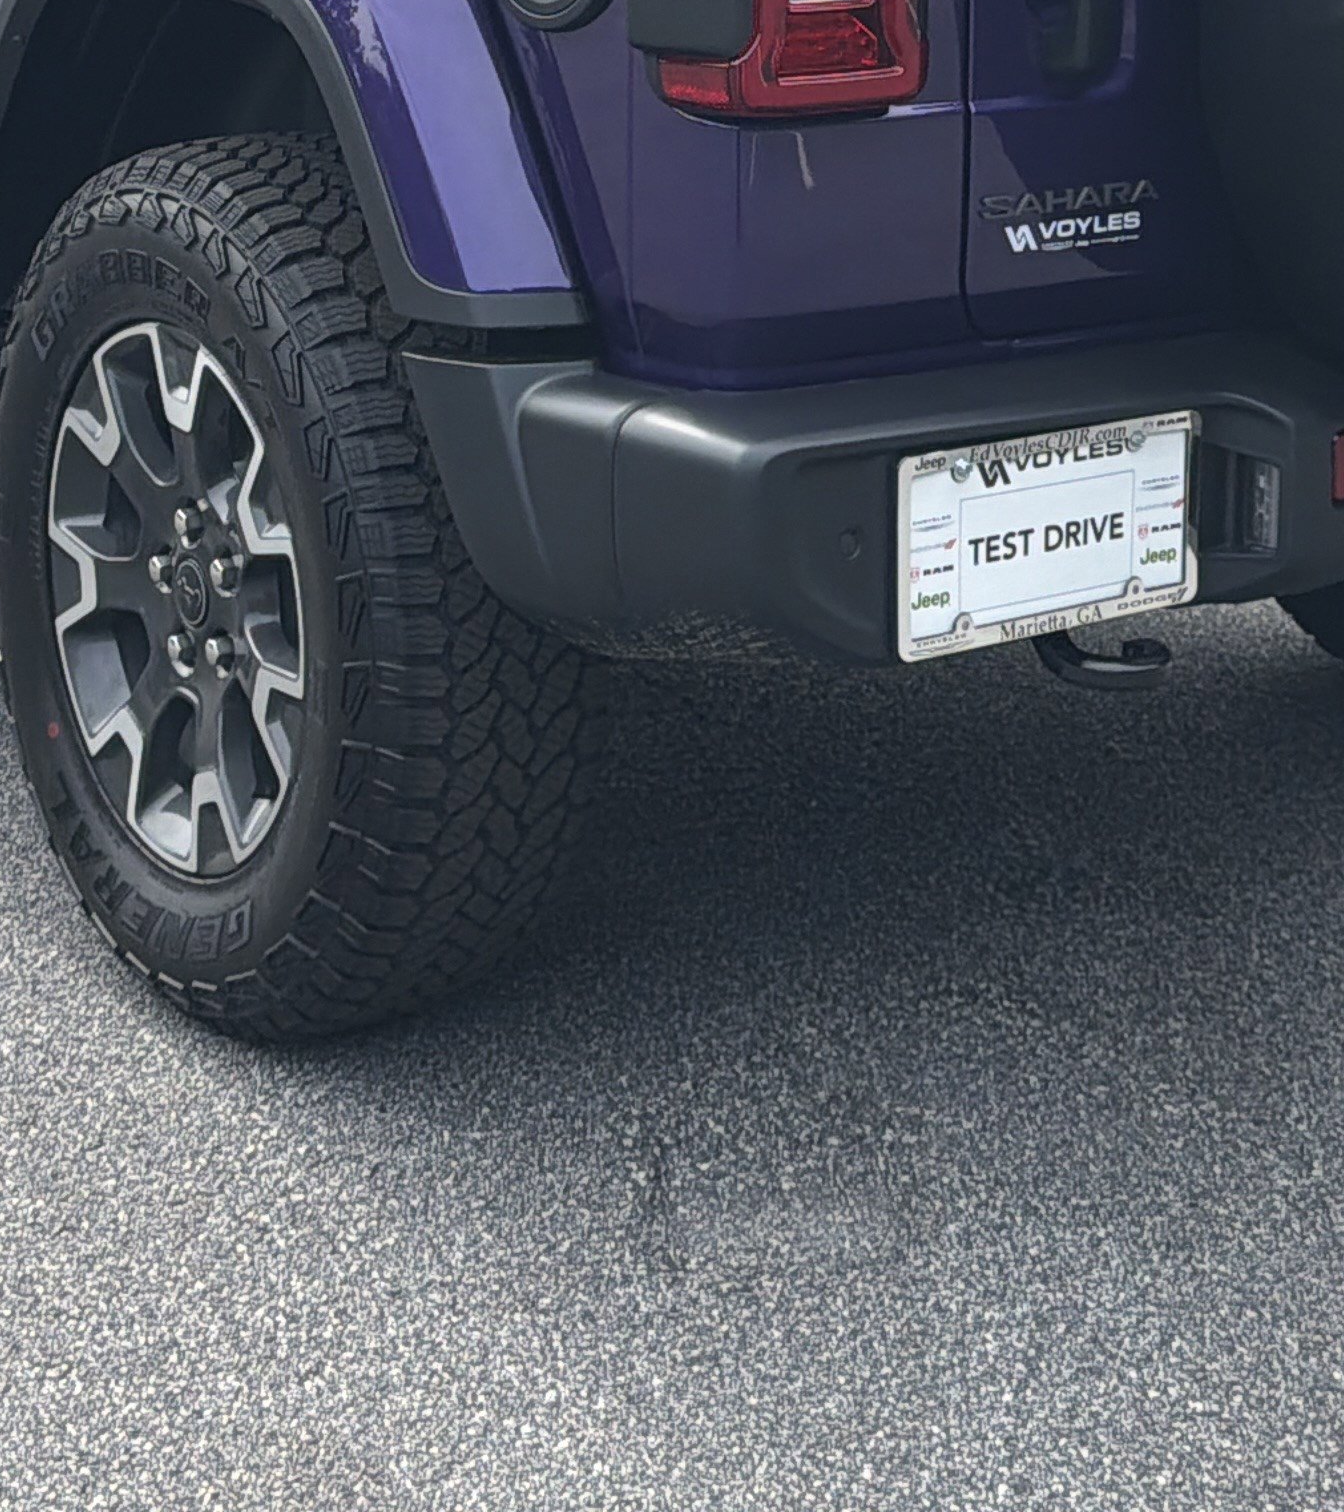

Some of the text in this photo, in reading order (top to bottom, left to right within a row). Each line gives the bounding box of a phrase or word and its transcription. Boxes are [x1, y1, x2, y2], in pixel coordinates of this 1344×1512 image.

[978, 179, 1159, 220] SAHARA
[1038, 210, 1142, 240] VOYLES
[1156, 416, 1188, 428] RAM
[914, 455, 947, 472] Jeep
[1015, 438, 1124, 472] VOYLES
[1152, 522, 1182, 534] RAM
[968, 512, 1125, 566] TEST DRIVE
[1139, 547, 1177, 565] Jeep
[922, 564, 955, 577] RAM
[911, 591, 951, 611] Jeep
[999, 604, 1103, 641] Marietta, GA
